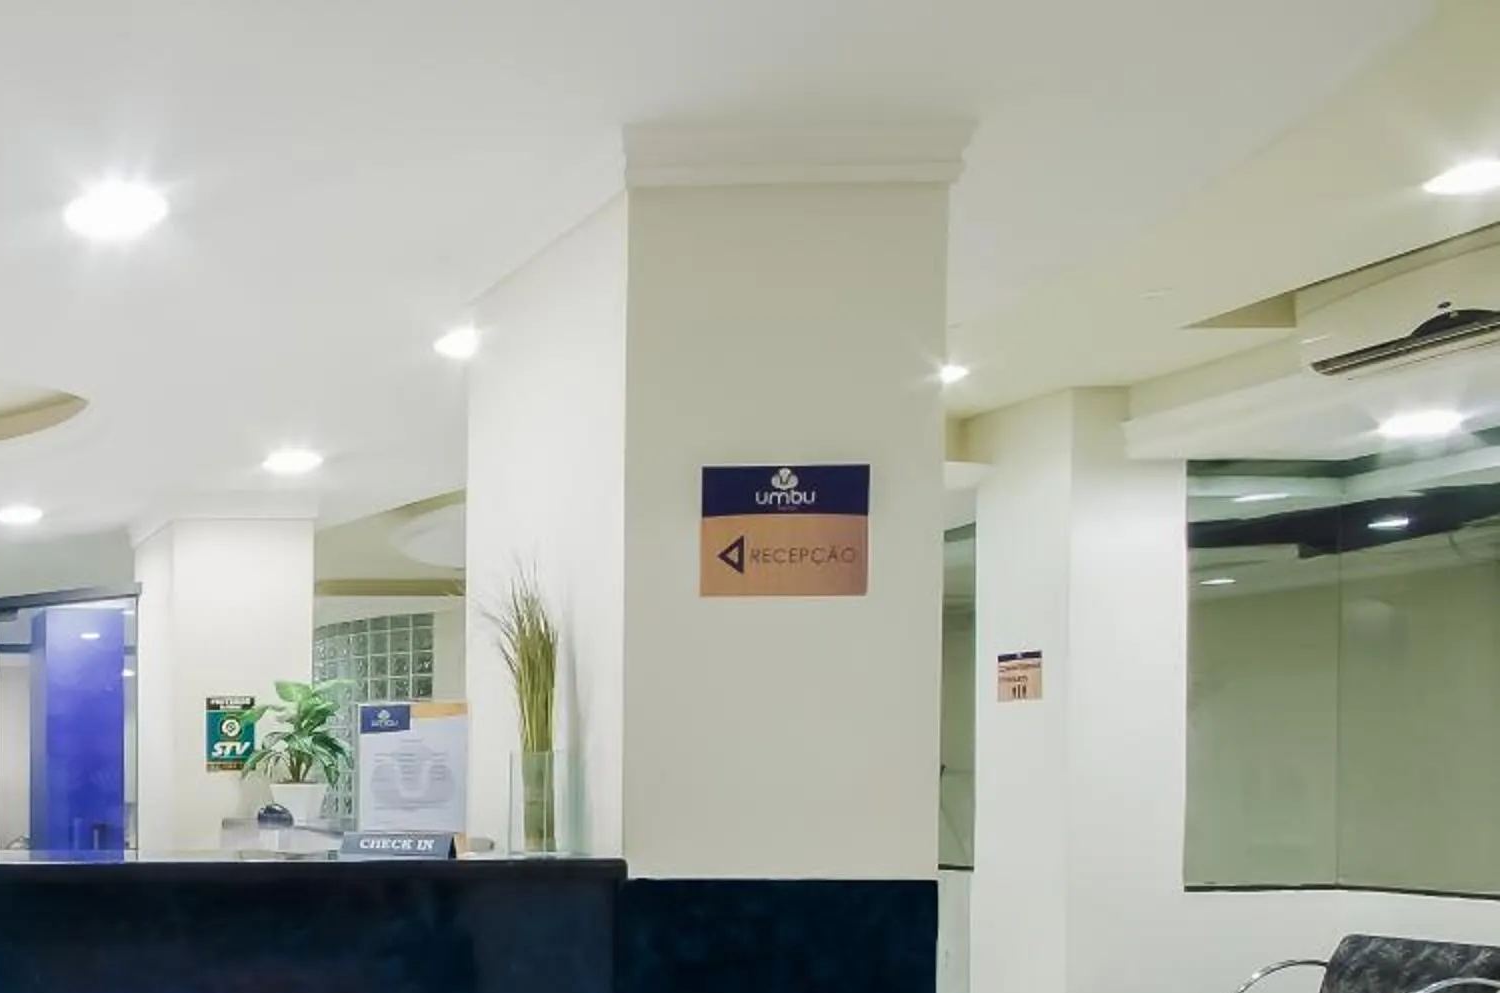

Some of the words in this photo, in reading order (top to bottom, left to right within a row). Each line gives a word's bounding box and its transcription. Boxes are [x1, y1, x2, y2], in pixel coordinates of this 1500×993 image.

[755, 489, 816, 505] umbu
[749, 545, 856, 565] RECEPÇÃO
[211, 741, 251, 757] STV
[359, 838, 411, 850] CHECK
[417, 839, 435, 851] IN
